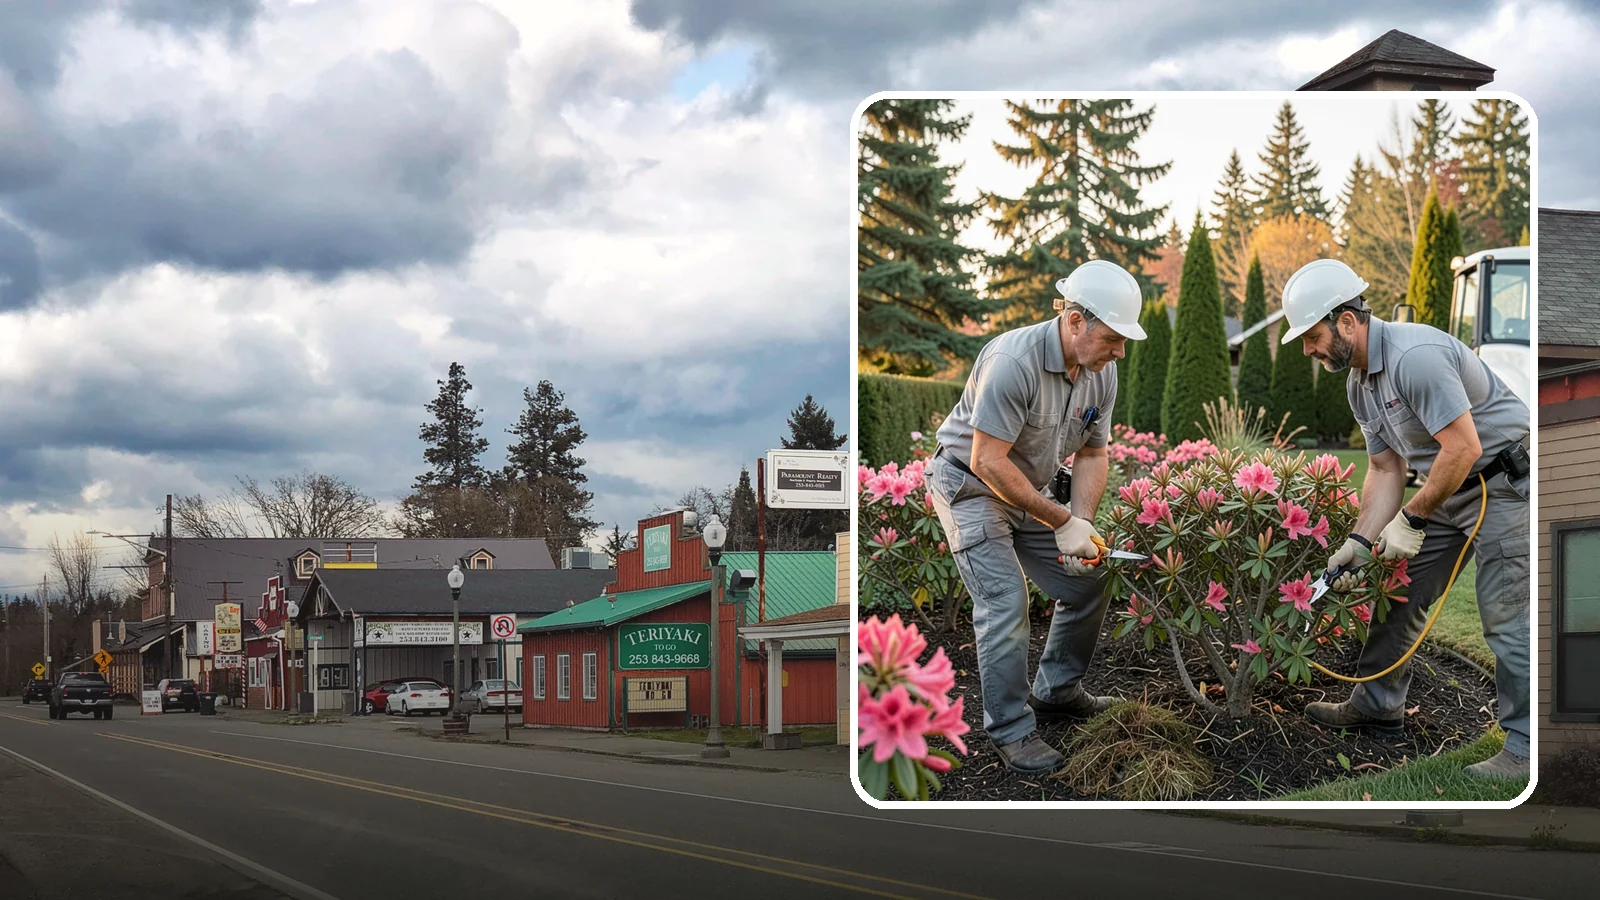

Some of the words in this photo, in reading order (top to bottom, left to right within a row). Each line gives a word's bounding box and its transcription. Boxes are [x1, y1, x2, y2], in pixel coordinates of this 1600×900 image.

[817, 472, 839, 480] REALTY
[624, 627, 702, 646] TERIYAKI
[629, 655, 648, 664] 253
[651, 654, 700, 664] 843-9668
